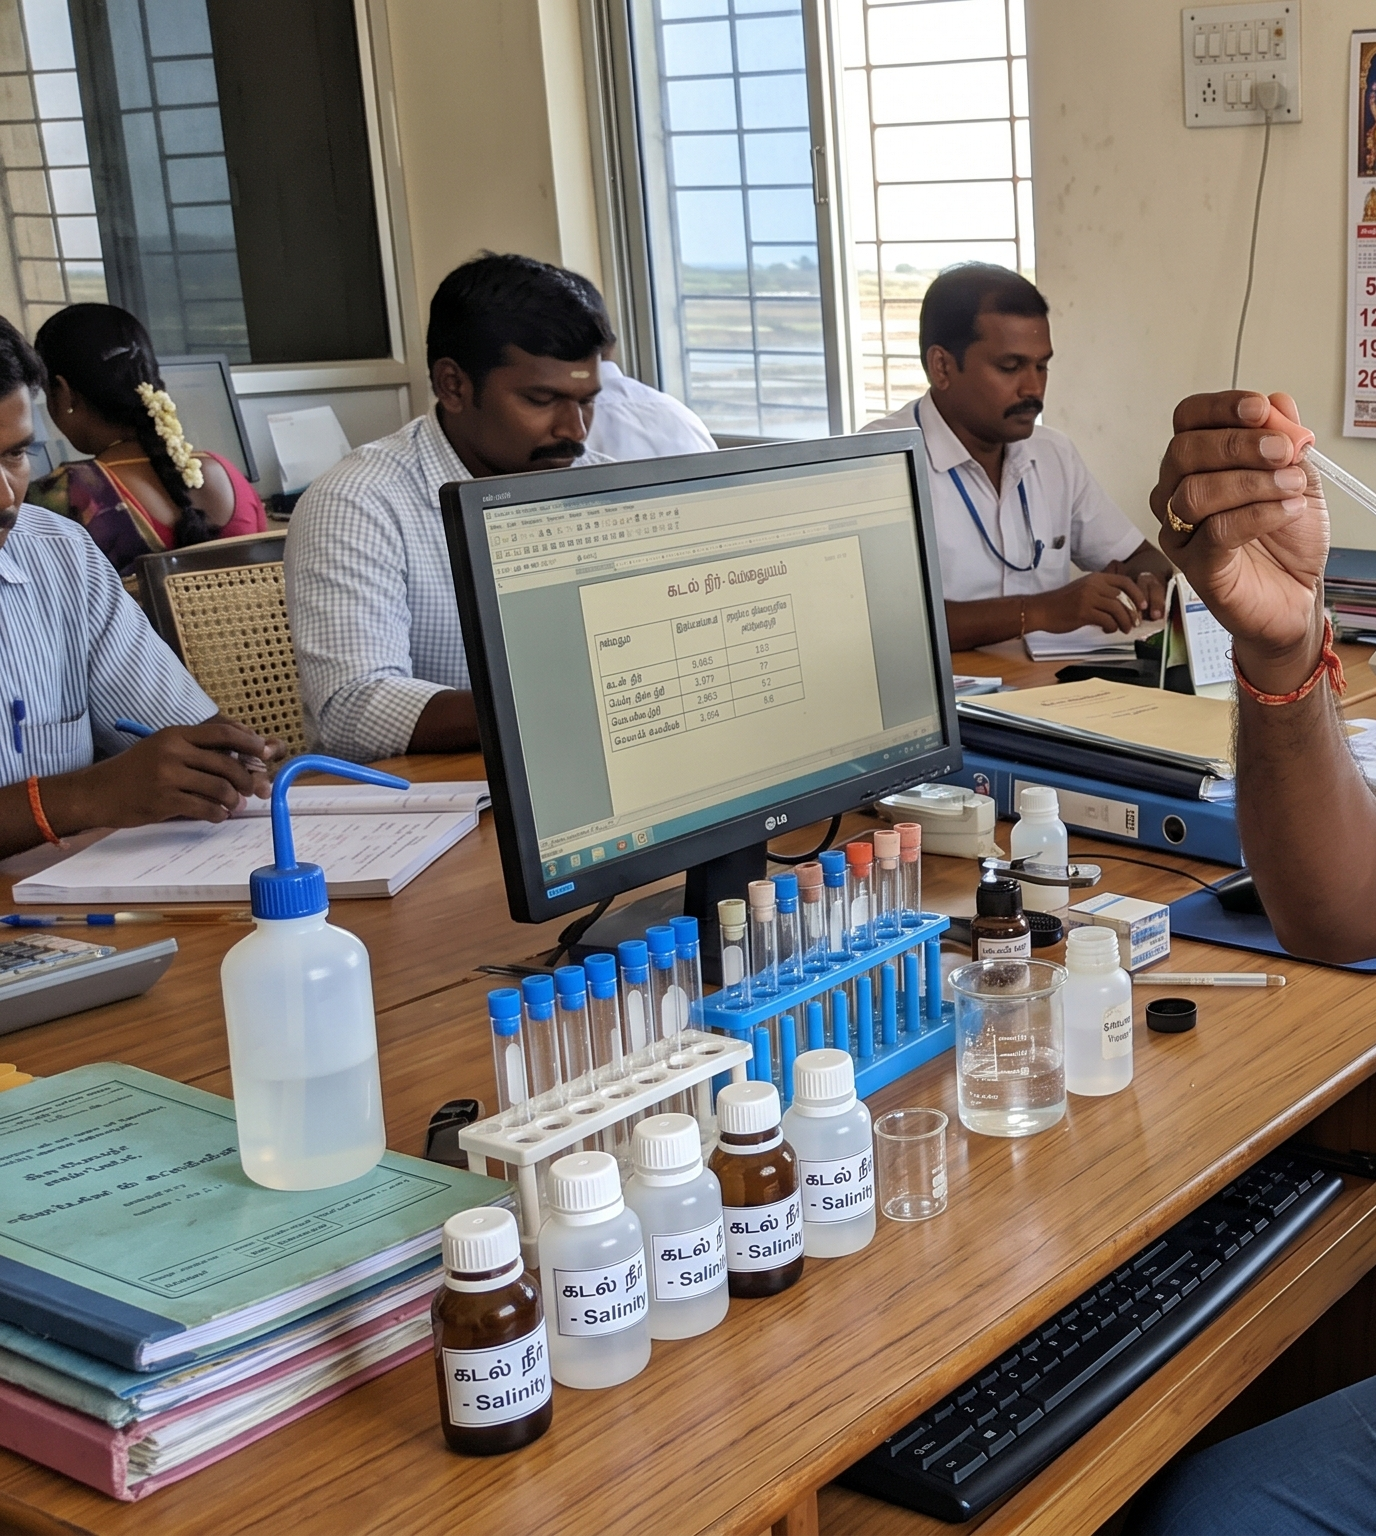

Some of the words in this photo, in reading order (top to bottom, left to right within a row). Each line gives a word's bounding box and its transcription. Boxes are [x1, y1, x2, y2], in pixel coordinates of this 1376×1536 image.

[1365, 276, 1376, 296] 5
[806, 1166, 852, 1186] கடல்
[729, 1213, 778, 1235] கடல்
[661, 1237, 711, 1261] கடல்
[562, 1276, 617, 1299] கடல்
[625, 1260, 643, 1293] நீர்
[584, 1291, 646, 1326] Salinity
[453, 1359, 511, 1383] கடல்
[521, 1340, 544, 1377] நீர்
[476, 1374, 547, 1411] Salinity
